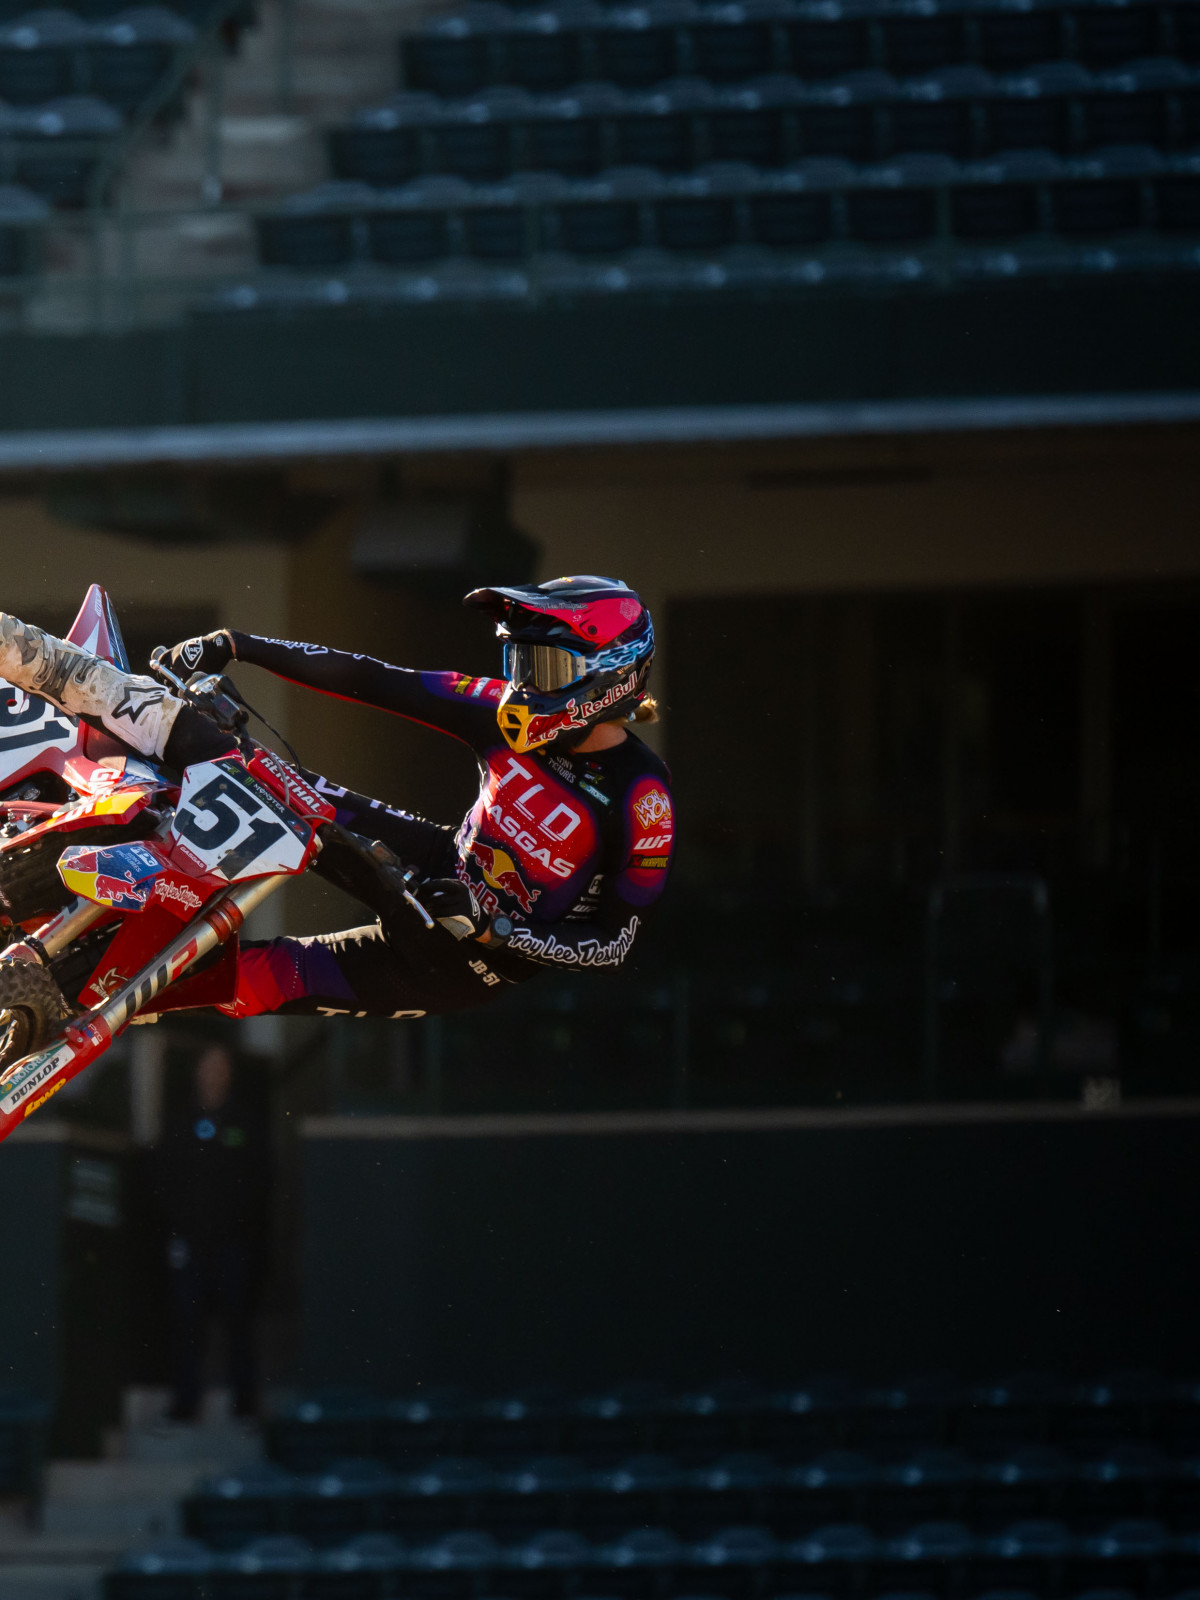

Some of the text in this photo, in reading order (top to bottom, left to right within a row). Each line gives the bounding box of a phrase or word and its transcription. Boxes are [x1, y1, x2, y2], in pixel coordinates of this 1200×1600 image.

[580, 670, 638, 718] Red Bull
[253, 783, 285, 814] MONSTER
[260, 757, 322, 813] RENTHAL
[496, 757, 581, 842] TLD
[174, 774, 288, 880] 51
[633, 834, 673, 850] WP
[115, 849, 143, 872] PICTURES
[179, 845, 206, 869] GASGAS
[154, 878, 202, 912] Troy Lee Designs
[509, 915, 640, 967] Troy Lee Designs
[468, 959, 501, 987] JB-51
[10, 1056, 61, 1105] DUNLOP
